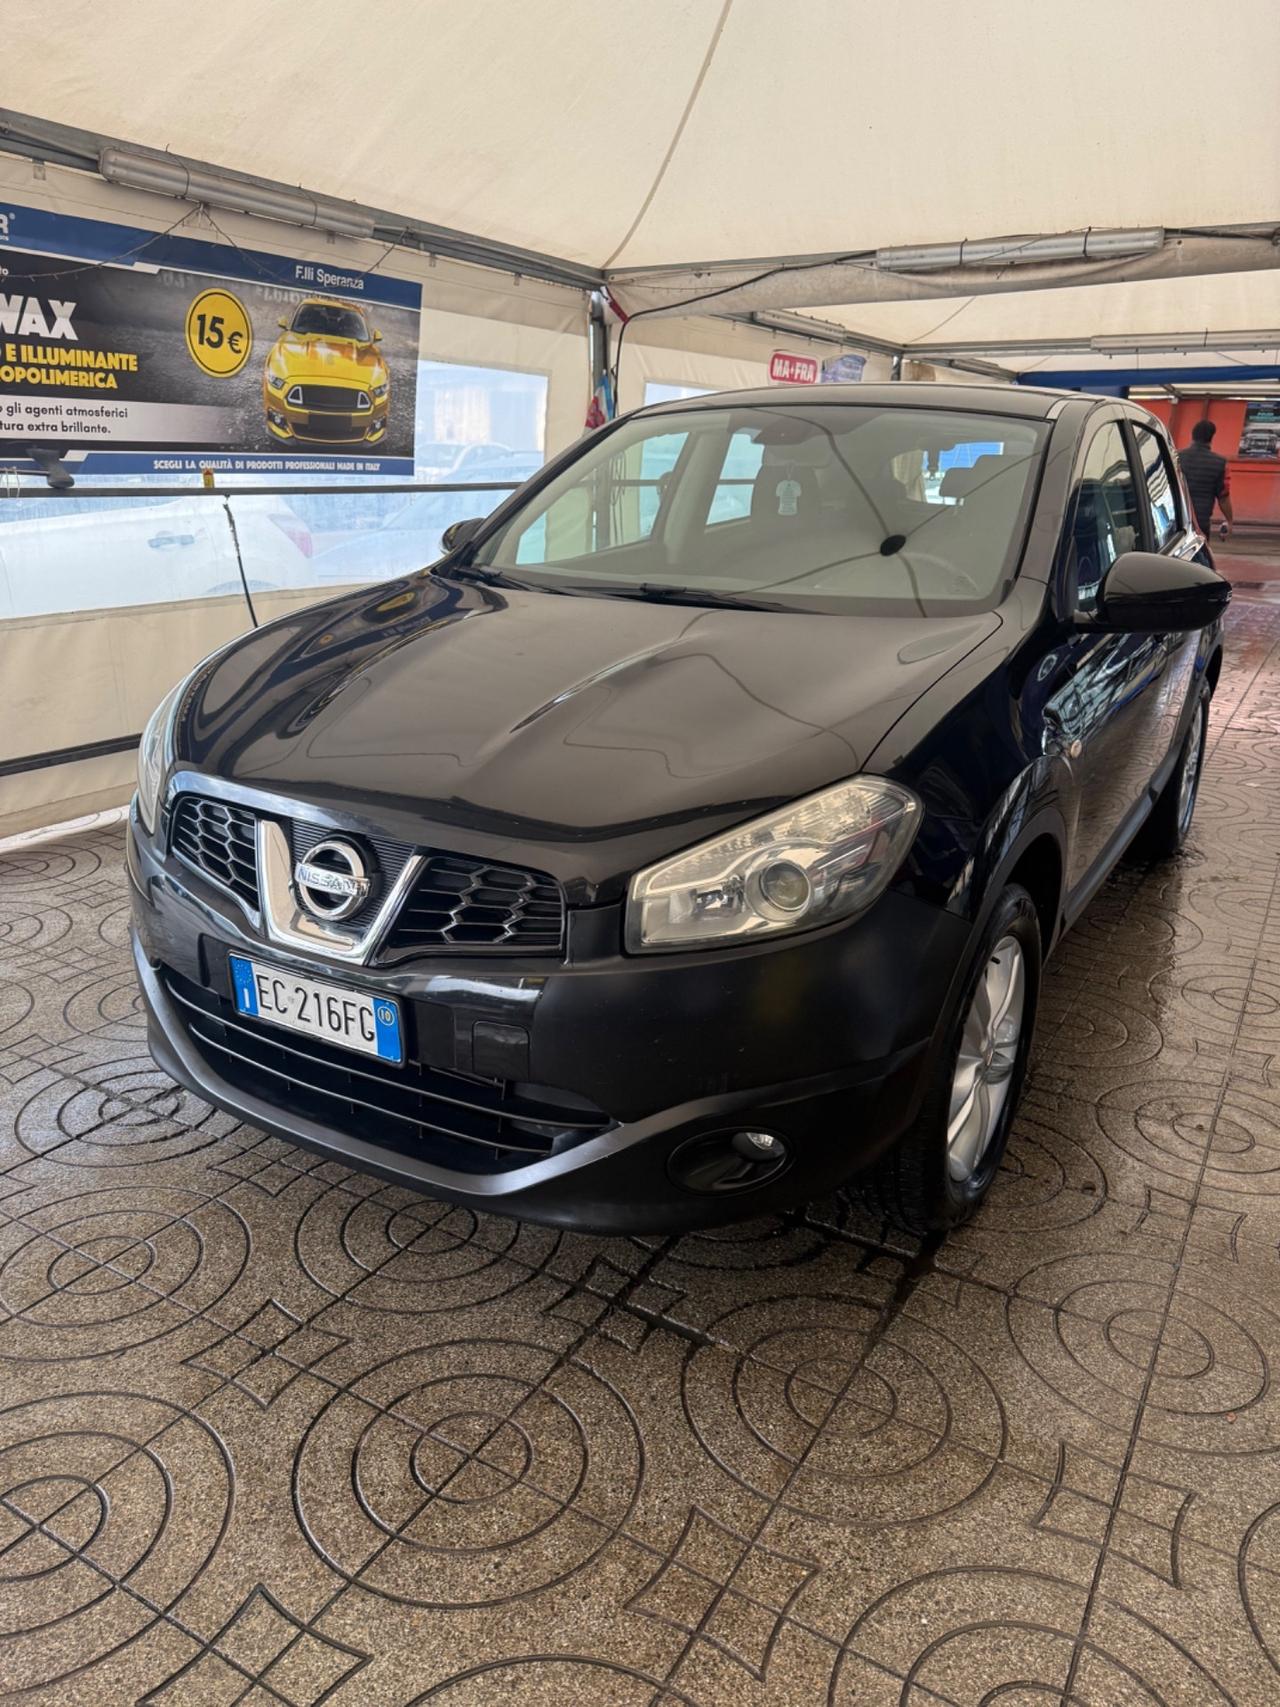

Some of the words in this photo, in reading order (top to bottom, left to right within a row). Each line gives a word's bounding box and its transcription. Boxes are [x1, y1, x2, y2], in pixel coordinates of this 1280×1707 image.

[317, 269, 364, 290] Speranza
[6, 343, 17, 362] E
[20, 344, 139, 372] ILLUMINANTE
[6, 402, 21, 417] gli
[25, 404, 63, 418] agenti
[66, 406, 128, 419] atmosferici
[27, 421, 58, 433] extra
[61, 421, 112, 434] brillante.
[153, 460, 182, 470] SCEGLI
[185, 460, 196, 469] LA
[199, 458, 233, 470] QUALITÀ
[235, 461, 244, 470] DI
[246, 461, 283, 470] PRODOTTI
[285, 461, 335, 471] PROFESSIONALI
[337, 462, 354, 471] MADE
[356, 462, 364, 471] IN
[365, 462, 380, 471] ITALY
[297, 865, 358, 893] NISSAN
